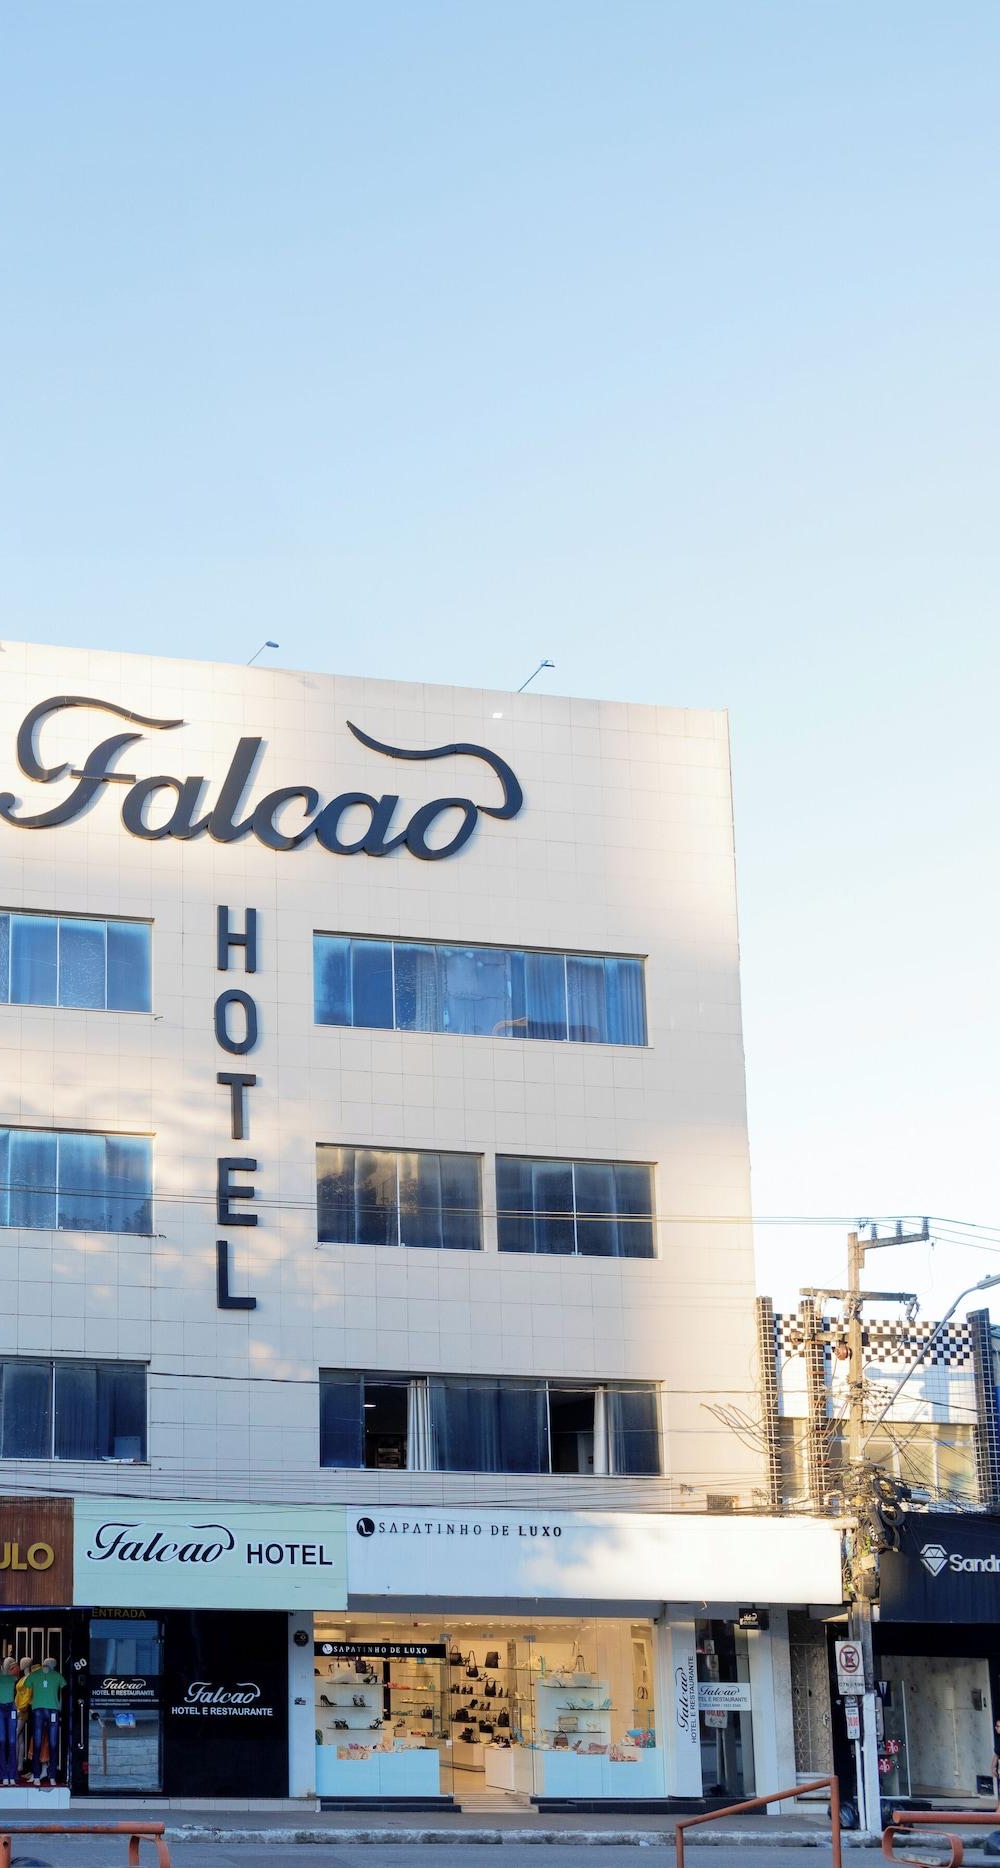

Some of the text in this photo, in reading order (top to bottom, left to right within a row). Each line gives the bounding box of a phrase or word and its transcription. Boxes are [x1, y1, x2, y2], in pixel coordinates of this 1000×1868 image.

[214, 904, 258, 1310] HOTEL
[378, 1522, 563, 1537] SAPATINHO DE LUXO
[246, 1543, 333, 1566] HOTEL
[91, 1608, 147, 1618] ENTRADA
[333, 1646, 387, 1654] SAPATINHO
[390, 1646, 400, 1654] DE
[73, 1658, 87, 1670] 80
[688, 1656, 696, 1710] RESTAURANTE
[171, 1706, 273, 1716] HOTEL E RESTAURANTE
